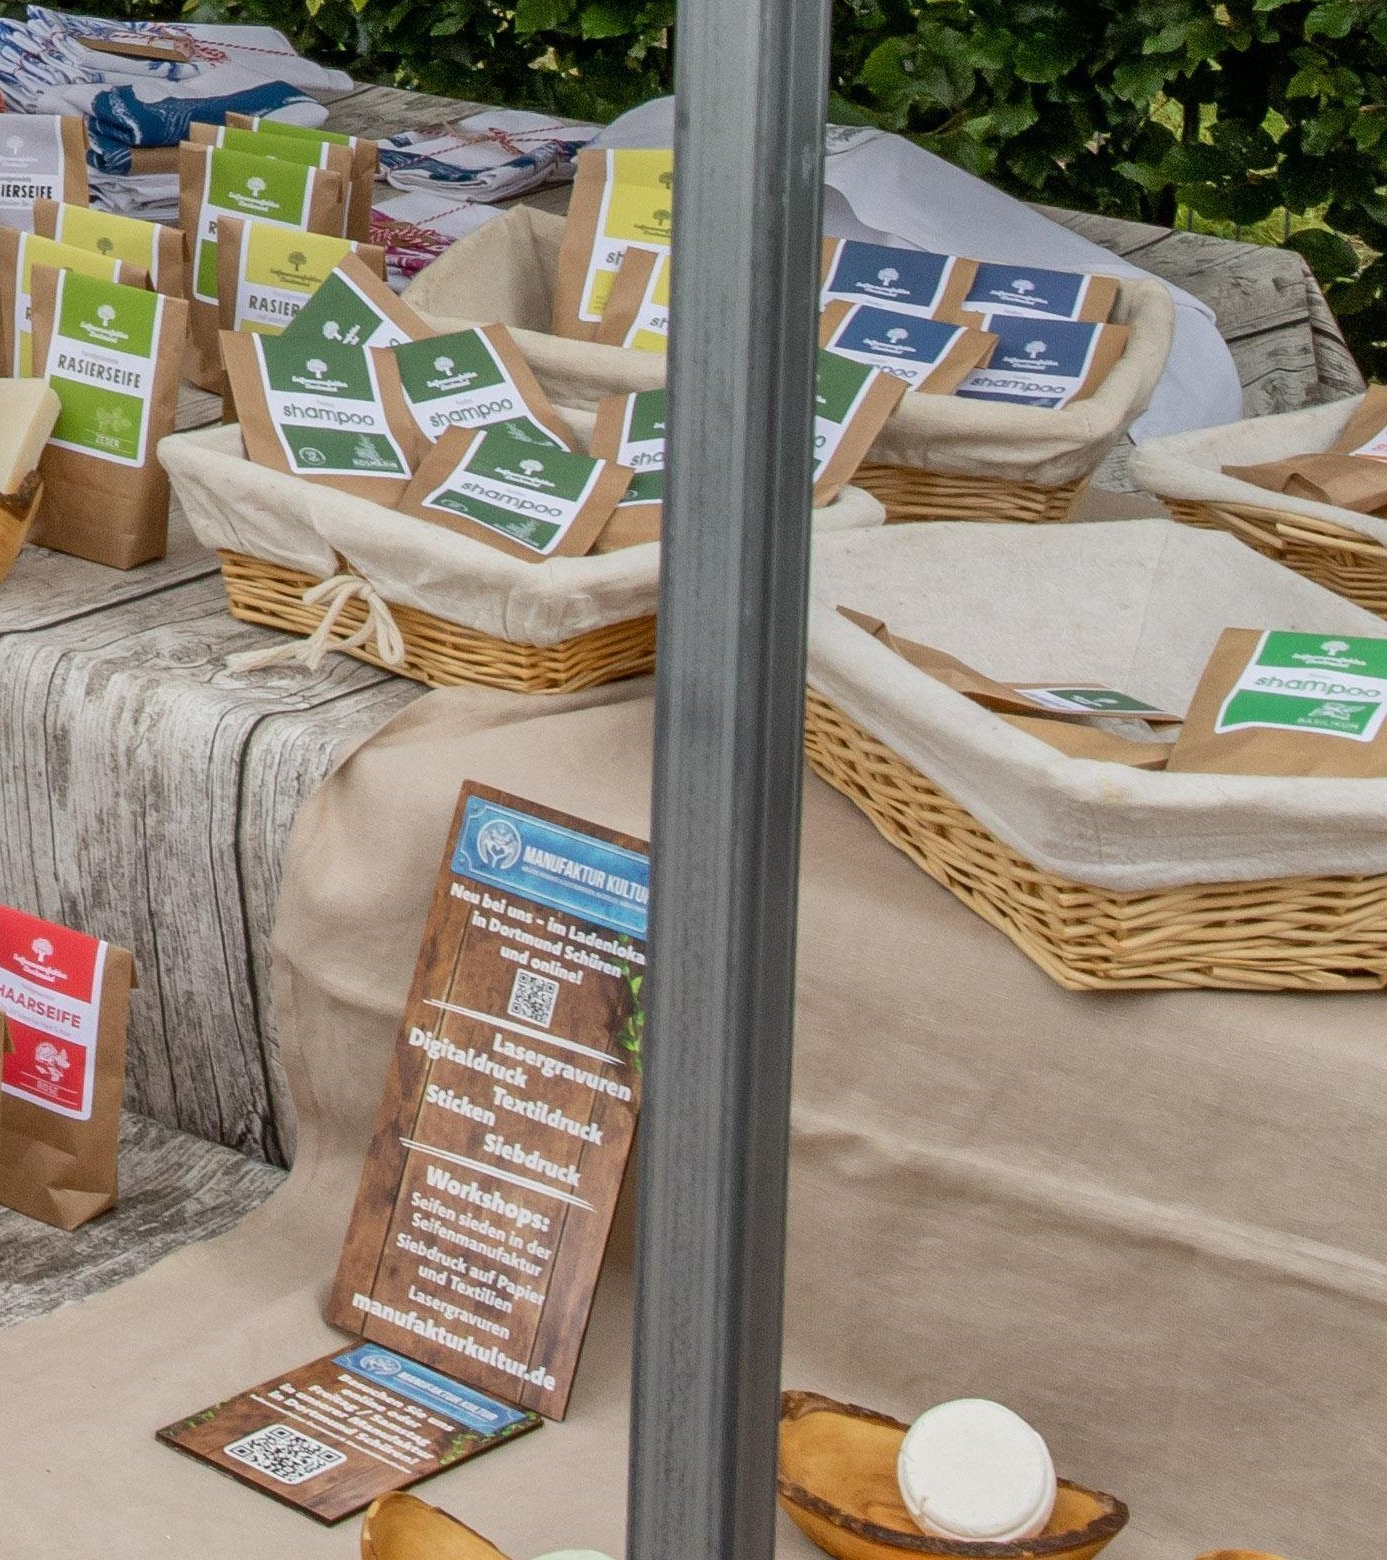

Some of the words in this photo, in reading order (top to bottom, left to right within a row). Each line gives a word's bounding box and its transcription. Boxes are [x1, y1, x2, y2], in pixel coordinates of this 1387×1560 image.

[248, 294, 301, 317] RASIER
[57, 353, 142, 389] RASIERSEIFE
[969, 376, 1067, 395] shampoo
[282, 403, 375, 427] shampoo
[428, 397, 514, 429] shampoo
[460, 480, 563, 519] shampoo
[1253, 674, 1382, 699] shampoo
[522, 845, 606, 890] MANUFAKTUR
[449, 882, 482, 905] Neu
[481, 893, 507, 915] bei
[507, 906, 533, 925] uns
[546, 917, 567, 937] im
[568, 925, 647, 967] Ladenloka
[471, 909, 488, 929] in
[487, 917, 564, 958] Dortmund
[563, 945, 623, 979] Schüren
[499, 945, 530, 966] und
[529, 956, 584, 986] online!
[407, 1026, 529, 1089] Digitaldruck
[492, 1032, 632, 1102] Lasergravuren
[425, 1084, 497, 1127] Sticken
[492, 1085, 604, 1146] Textildruck
[482, 1133, 581, 1187] Siebdruck
[411, 1190, 457, 1222] Seifen
[457, 1212, 507, 1242] sieden
[508, 1231, 524, 1249] in
[526, 1239, 552, 1260] der
[426, 1164, 551, 1233] Workshops:
[395, 1232, 468, 1275] Siebdruck
[469, 1263, 498, 1286] auf
[496, 1273, 546, 1306] Papier
[411, 1212, 543, 1277] Seifenmanufaktur
[407, 1285, 510, 1340] Lasergravuren
[417, 1264, 448, 1286] und
[448, 1274, 513, 1314] Textilien
[351, 1292, 557, 1392] manufakturkultur.de
